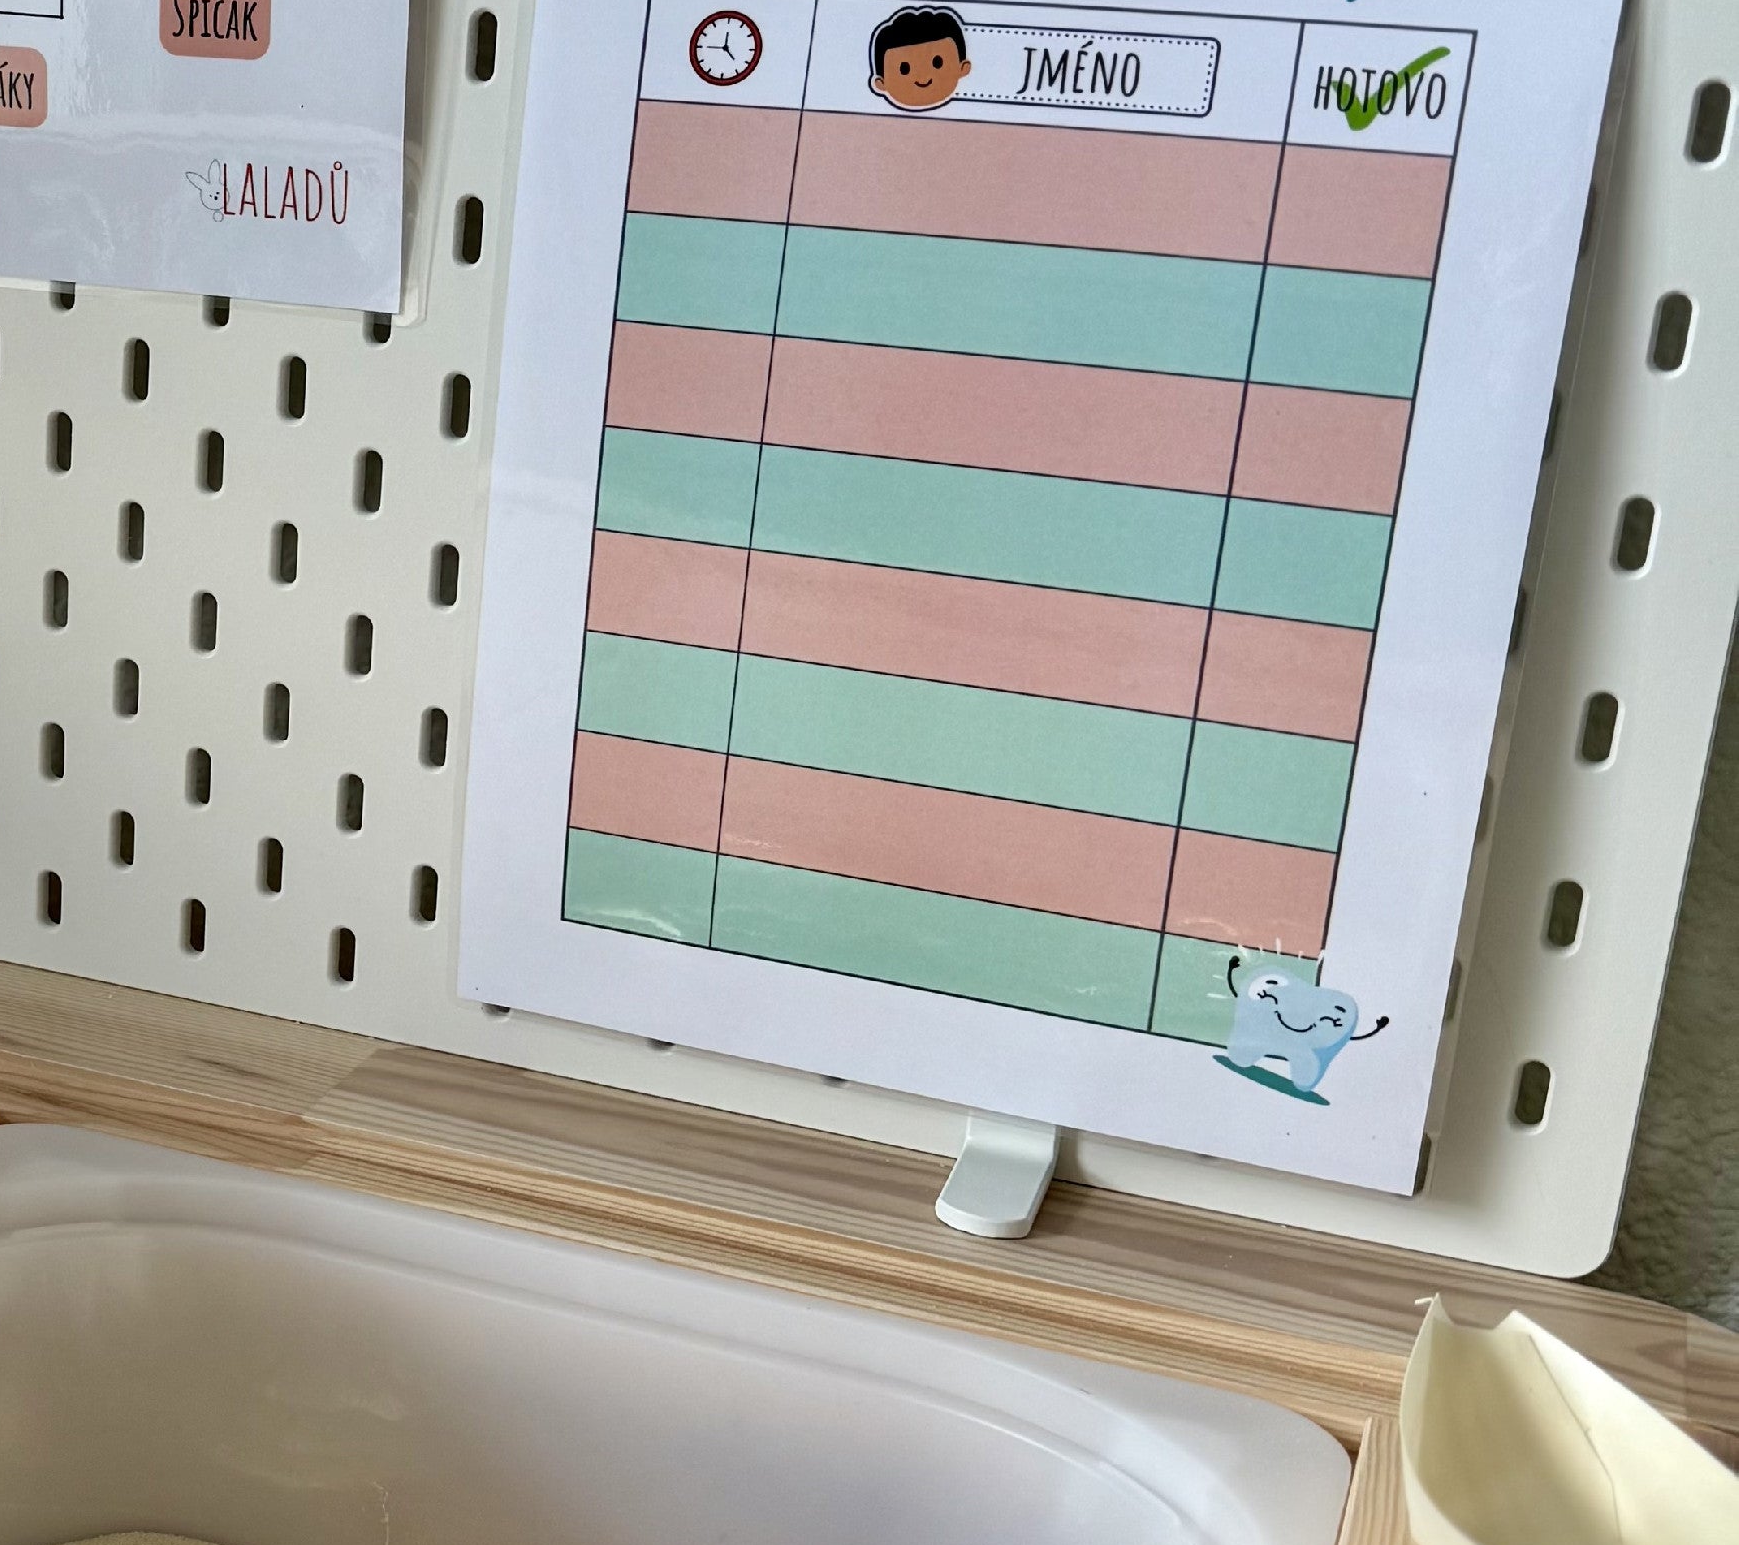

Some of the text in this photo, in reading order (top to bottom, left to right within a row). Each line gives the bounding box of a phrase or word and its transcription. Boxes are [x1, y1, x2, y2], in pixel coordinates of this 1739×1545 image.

[1015, 40, 1142, 98] JMÉNO
[1312, 65, 1448, 120] HOTOVO
[219, 160, 351, 226] LALADŮ
